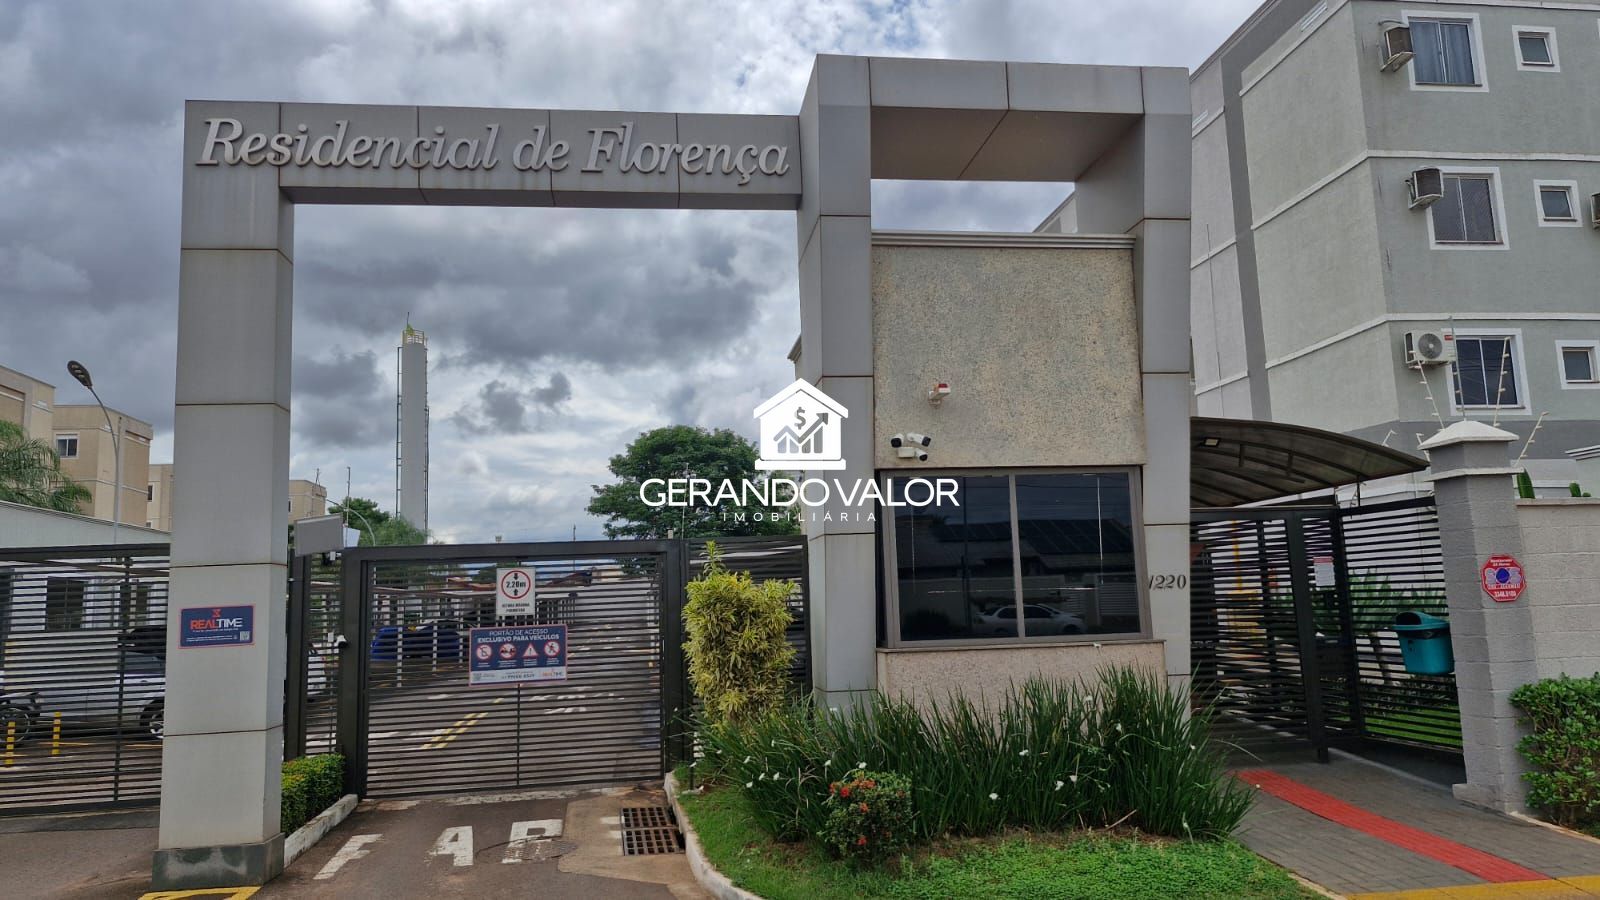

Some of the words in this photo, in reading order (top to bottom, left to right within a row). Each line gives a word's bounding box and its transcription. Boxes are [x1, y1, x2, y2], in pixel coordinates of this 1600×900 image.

[196, 118, 498, 168] Residencial
[513, 125, 569, 171] de
[582, 122, 790, 185] Florença
[190, 617, 243, 630] REALTIME
